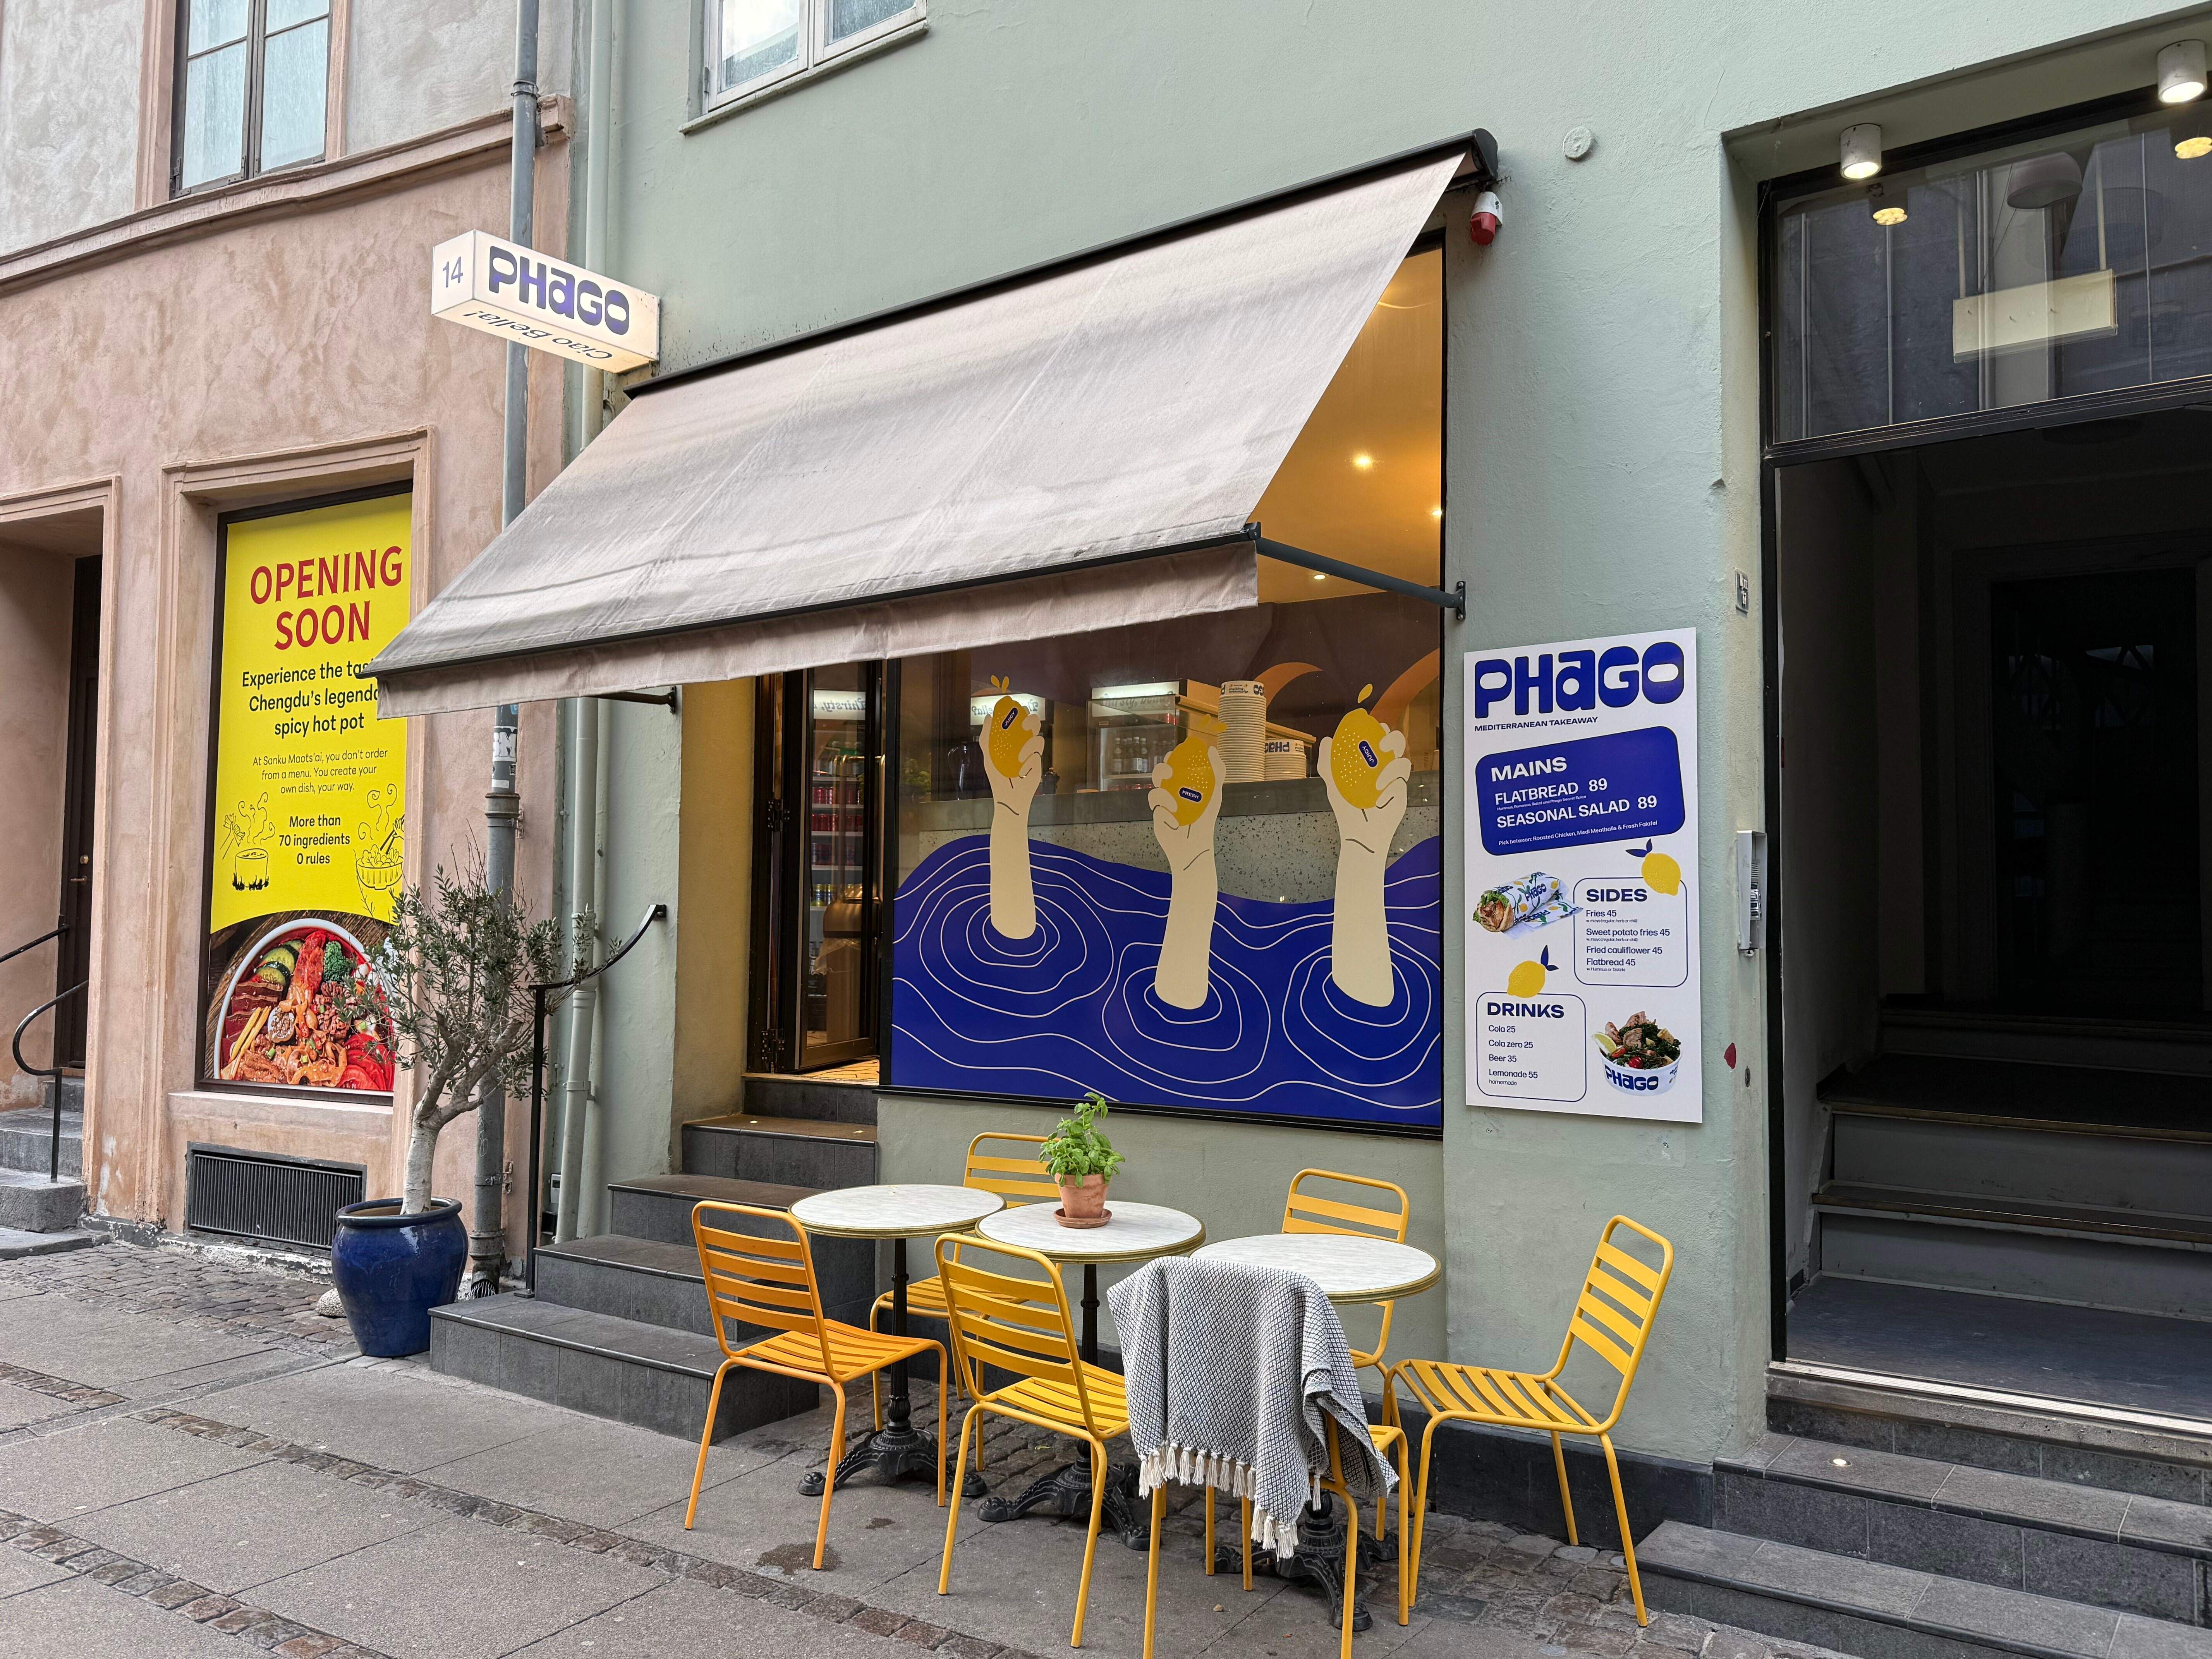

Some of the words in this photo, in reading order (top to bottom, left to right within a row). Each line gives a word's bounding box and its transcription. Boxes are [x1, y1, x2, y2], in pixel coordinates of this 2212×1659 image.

[443, 256, 463, 288] 14
[463, 311, 553, 338] Bella!
[552, 338, 613, 359] Ciao
[251, 546, 402, 604] OPENING
[274, 600, 371, 650] SOON
[242, 667, 316, 690] Experience
[320, 661, 342, 679] the
[249, 690, 321, 713] Chengdu's
[275, 718, 309, 739] spicy
[313, 715, 336, 732] hot
[340, 713, 364, 734] pot
[1005, 711, 1015, 726] JUICY
[1475, 721, 1547, 732] MEDITERRANEAN
[1549, 717, 1598, 726] TAKEAWAY
[253, 757, 261, 766] At
[263, 754, 286, 766] Sanku
[342, 750, 363, 760] don't
[365, 748, 388, 759] order
[1362, 746, 1374, 763] JUICY
[262, 770, 279, 780] from
[288, 770, 311, 778] menu.
[314, 767, 328, 777] You
[330, 766, 357, 776] create
[359, 766, 377, 777] your
[1491, 756, 1567, 781] MAINS
[281, 785, 296, 794] own
[298, 783, 316, 794] dish,
[318, 783, 335, 795] your
[337, 783, 354, 793] way.
[1182, 790, 1199, 799] FRESH
[1495, 782, 1578, 805] FLATBREAD
[1589, 778, 1607, 792] 89
[1497, 807, 1577, 828] SEASONAL
[1578, 799, 1630, 817] SALAD
[1638, 795, 1657, 809] 89
[289, 816, 315, 827] More
[318, 814, 340, 826] than
[279, 835, 291, 846] 70
[294, 833, 350, 849] ingredients
[297, 853, 303, 864] 0
[306, 852, 330, 864] rules
[1586, 888, 1647, 902] SIDES
[1487, 1002, 1564, 1018] DRINKS
[1489, 1069, 1527, 1078] Lemonade
